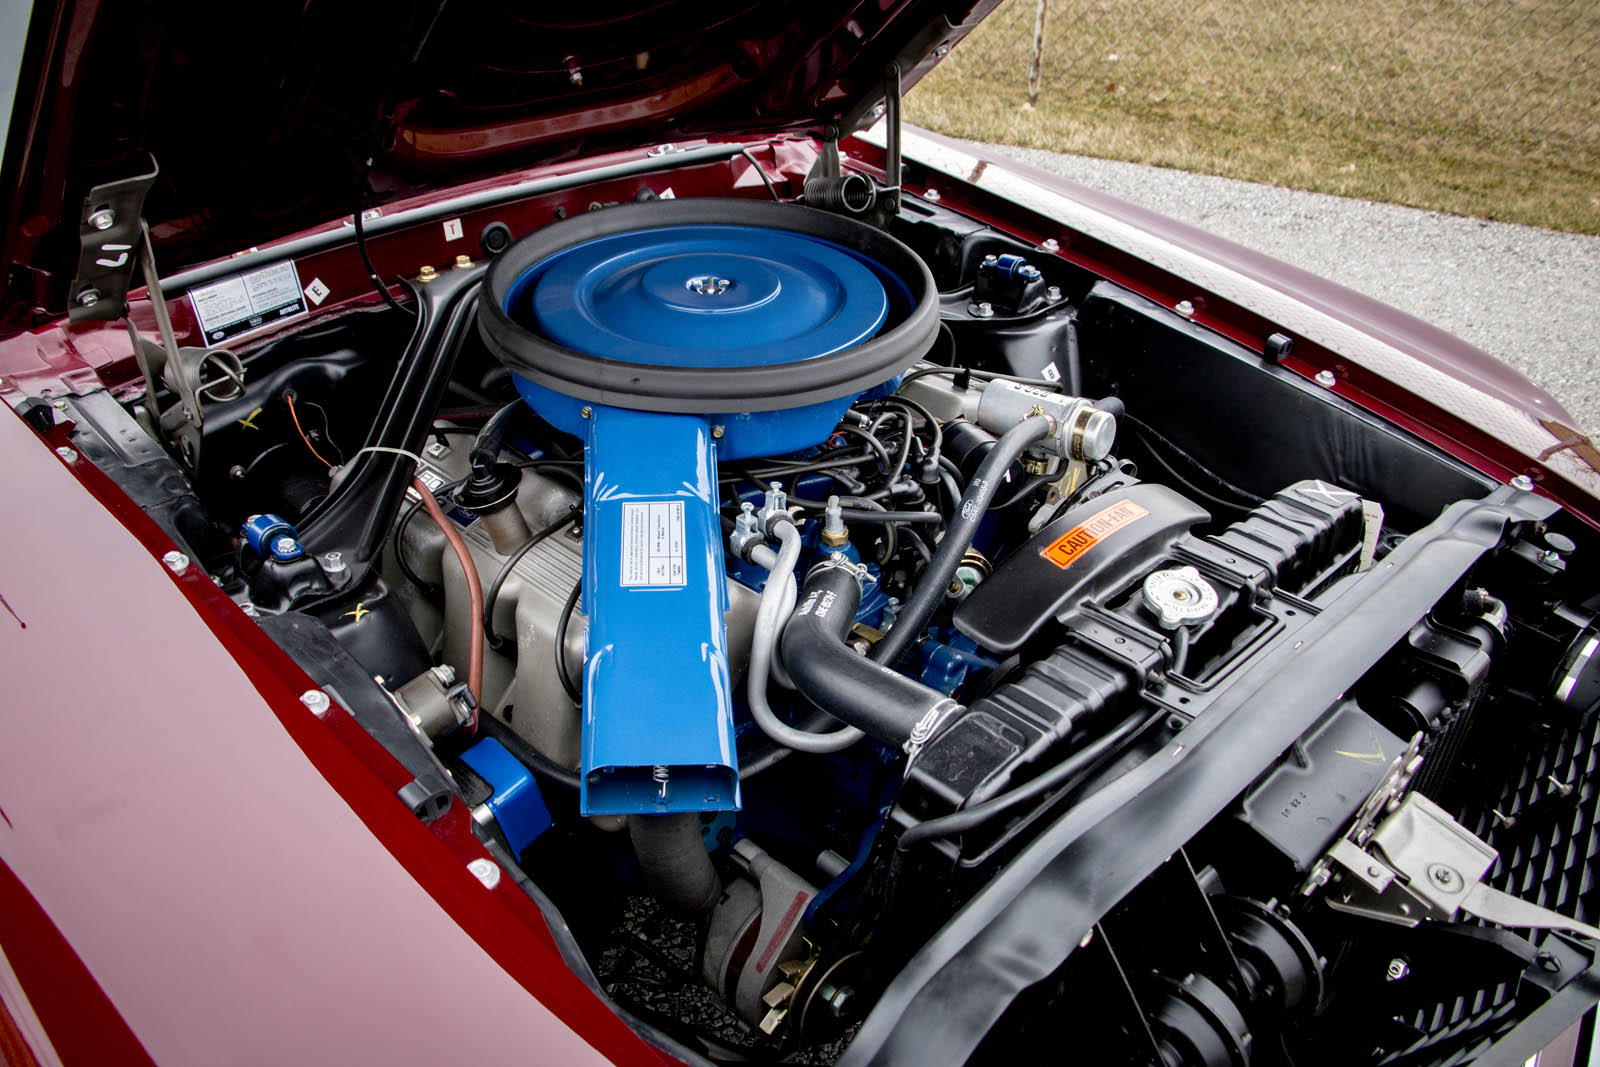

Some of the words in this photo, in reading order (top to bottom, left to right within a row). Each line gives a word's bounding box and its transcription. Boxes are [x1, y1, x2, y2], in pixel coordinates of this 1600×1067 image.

[449, 223, 456, 236] T
[311, 285, 323, 298] E
[1047, 369, 1056, 380] B
